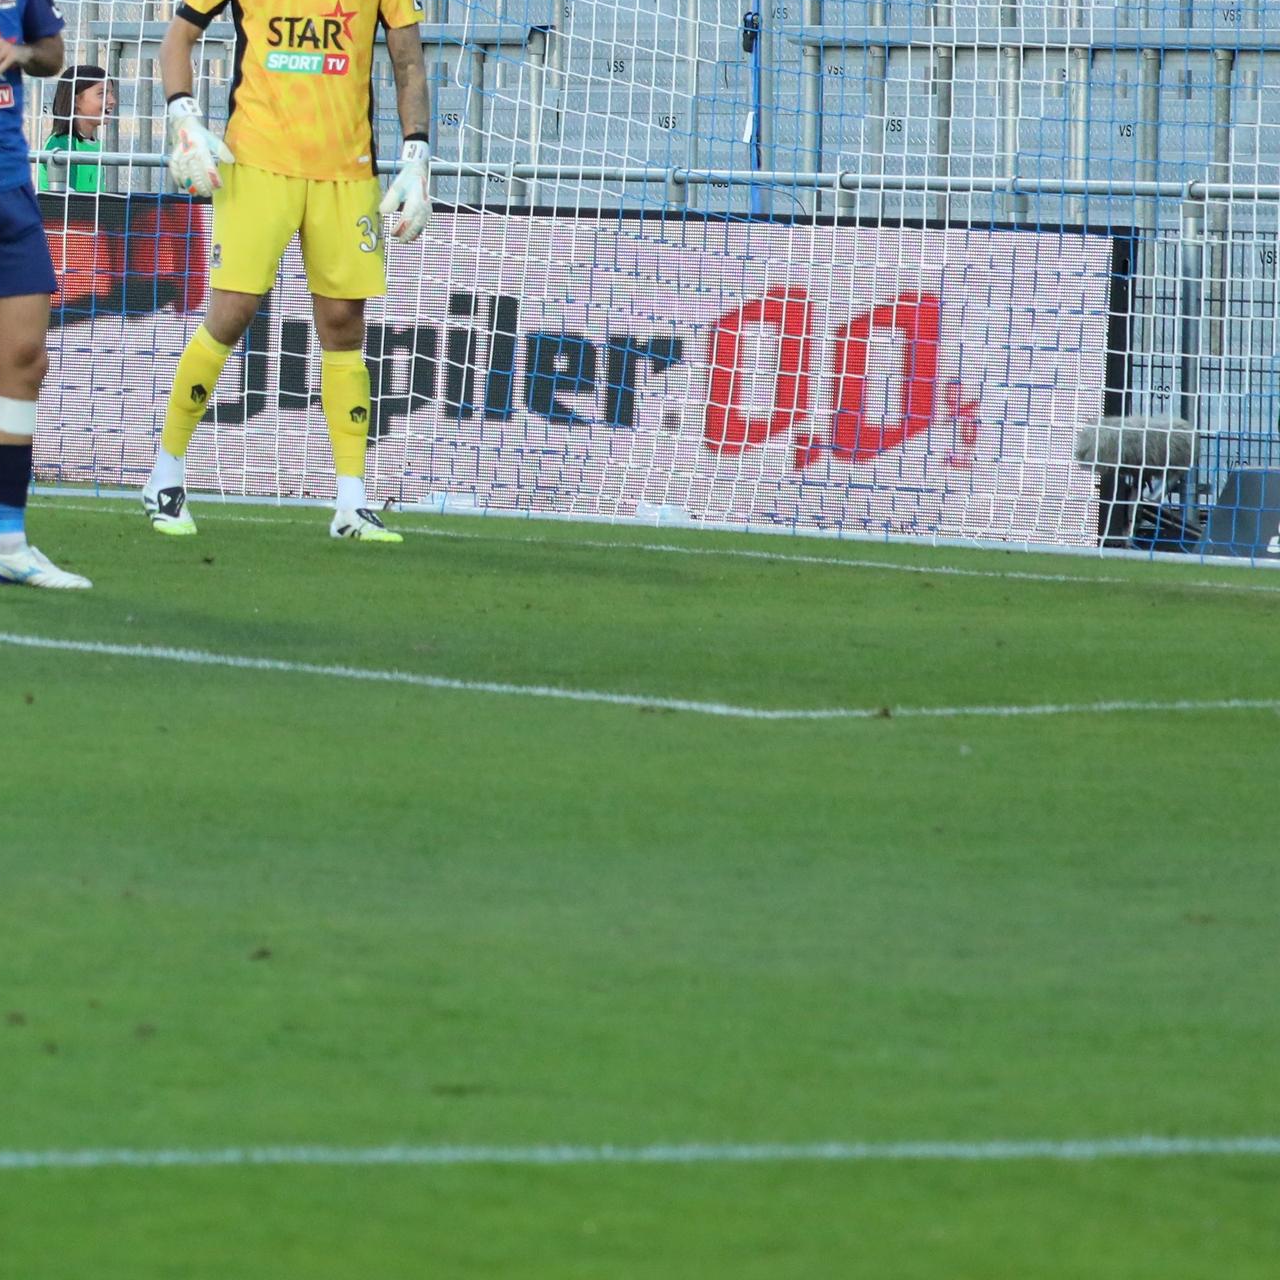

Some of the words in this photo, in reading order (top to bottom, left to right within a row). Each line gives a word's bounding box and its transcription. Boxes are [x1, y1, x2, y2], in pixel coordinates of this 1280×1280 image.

[266, 16, 346, 51] STAR
[267, 53, 323, 70] SPORT
[327, 57, 346, 71] TV
[606, 61, 625, 73] VSS
[441, 114, 458, 126] VSS
[658, 116, 677, 129] VSS
